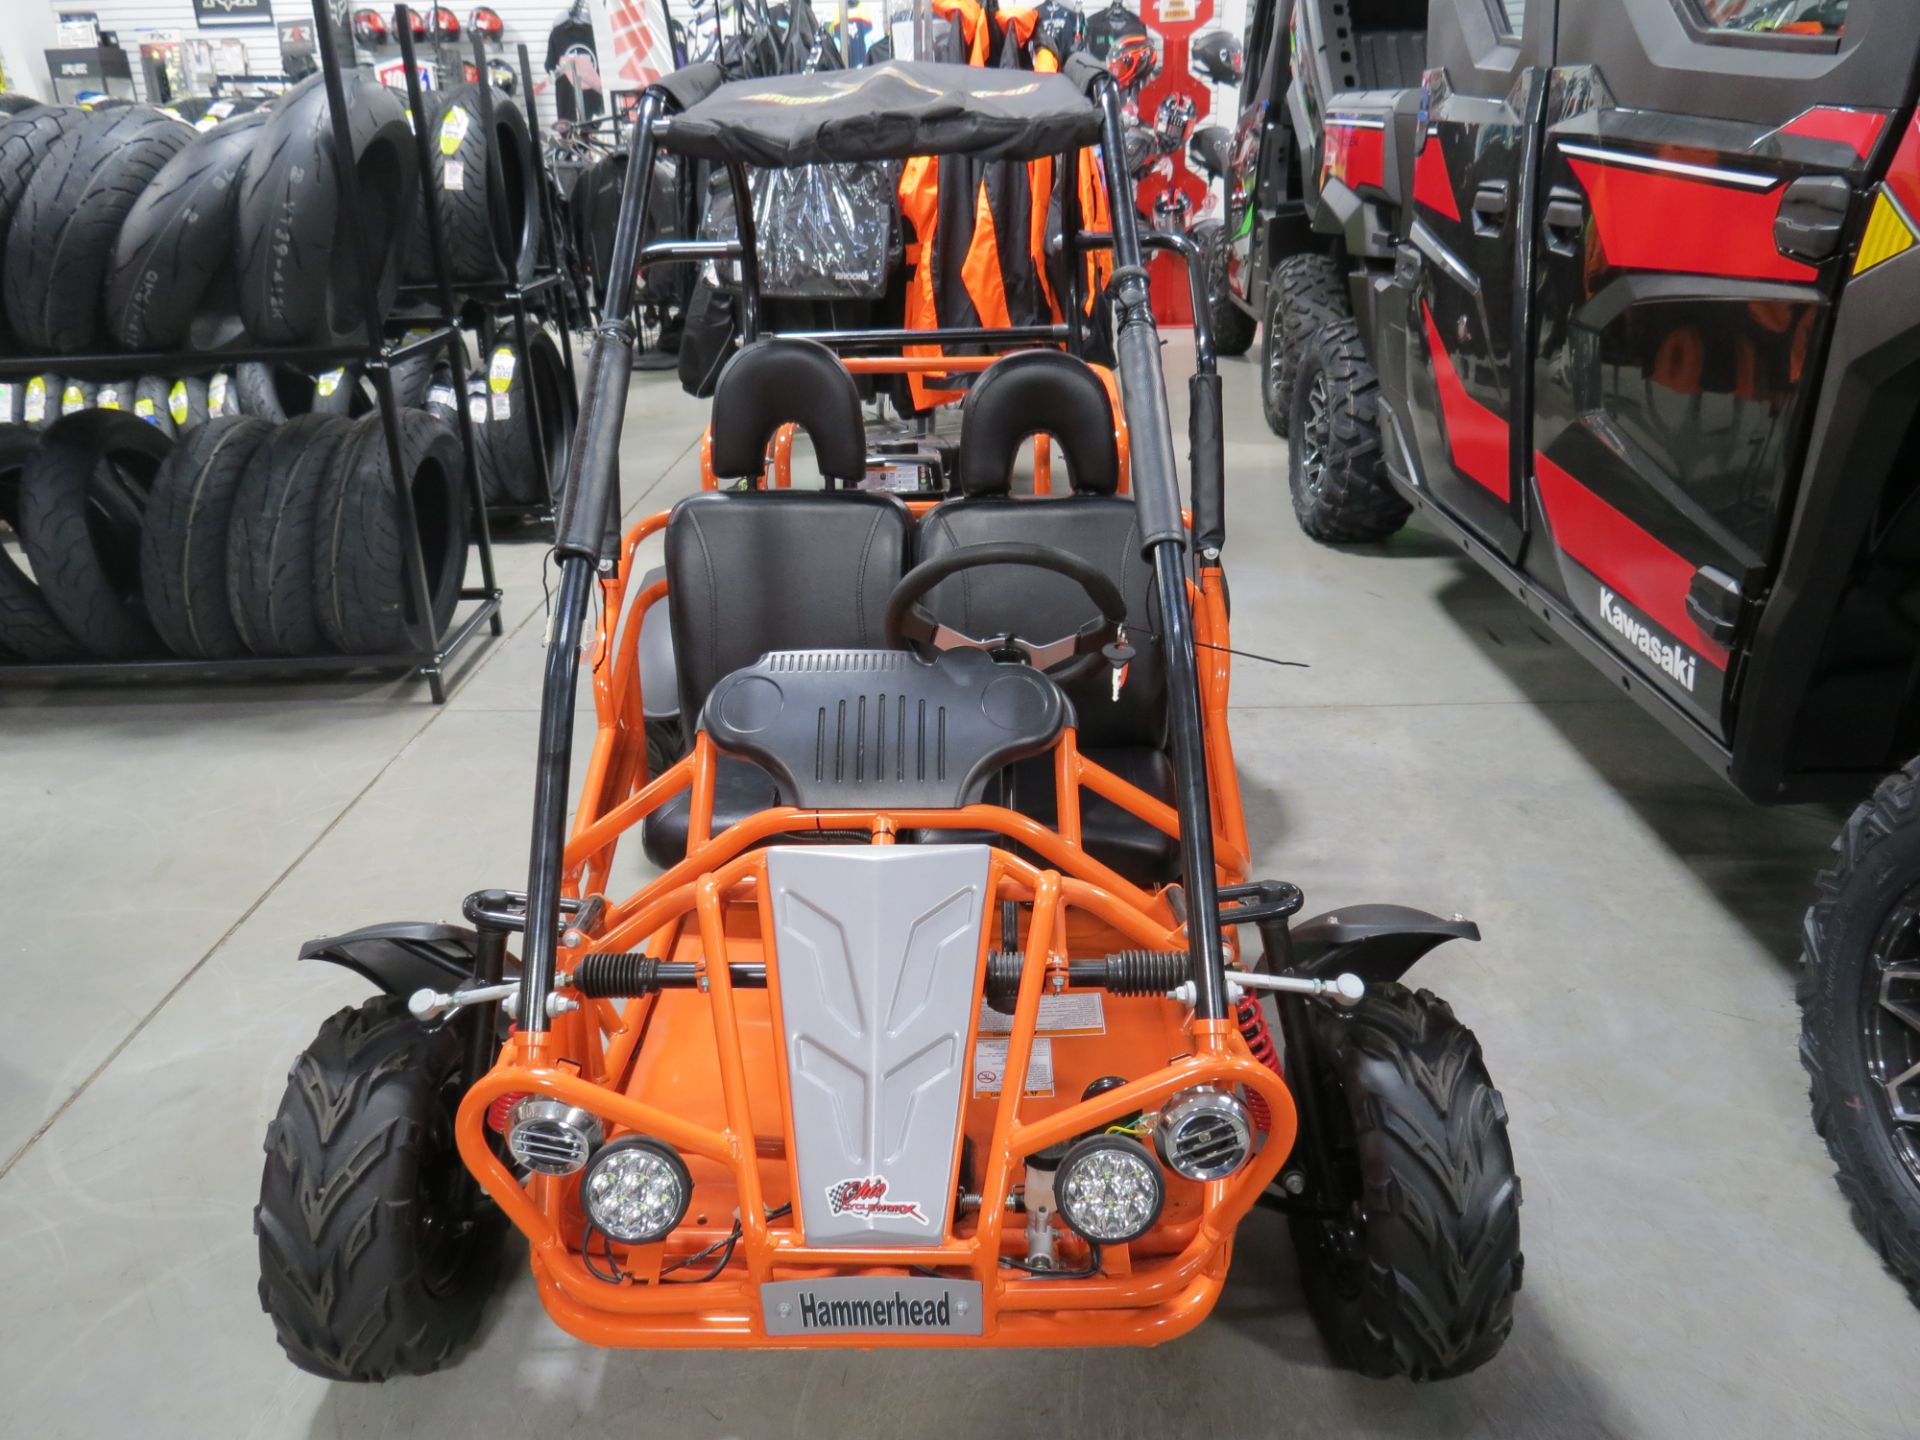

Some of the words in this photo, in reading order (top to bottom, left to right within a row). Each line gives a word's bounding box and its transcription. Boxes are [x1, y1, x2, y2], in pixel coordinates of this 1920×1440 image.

[1599, 586, 1697, 692] Kawasaki
[841, 1179, 887, 1205] Ohio
[799, 1291, 950, 1328] Hammerhead
